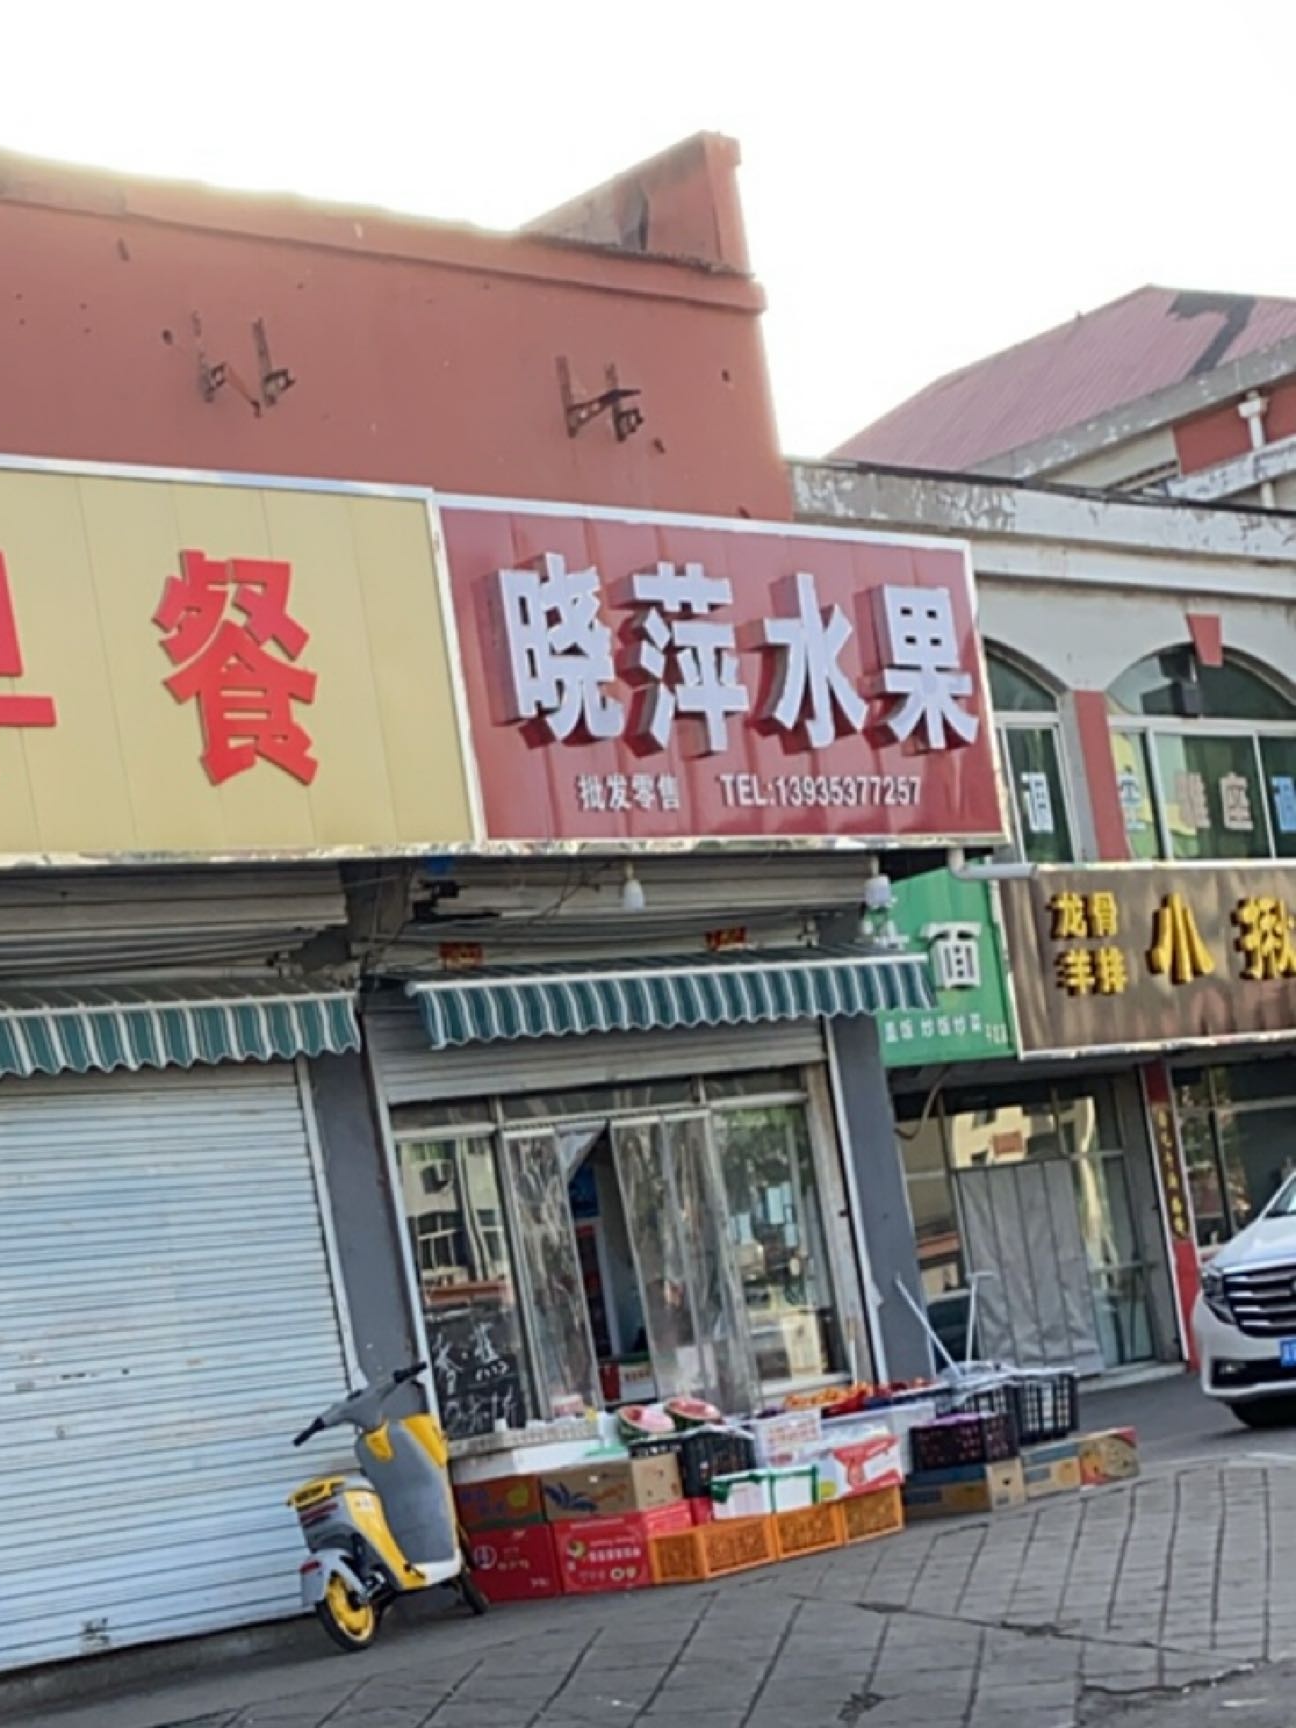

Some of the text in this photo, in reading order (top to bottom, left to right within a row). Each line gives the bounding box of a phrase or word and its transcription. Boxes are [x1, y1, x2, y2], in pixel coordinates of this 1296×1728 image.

[492, 552, 980, 751] 晓萍水果
[577, 773, 680, 812] 批发零售
[720, 774, 921, 806] TEL:13935377257
[921, 921, 981, 988] 面
